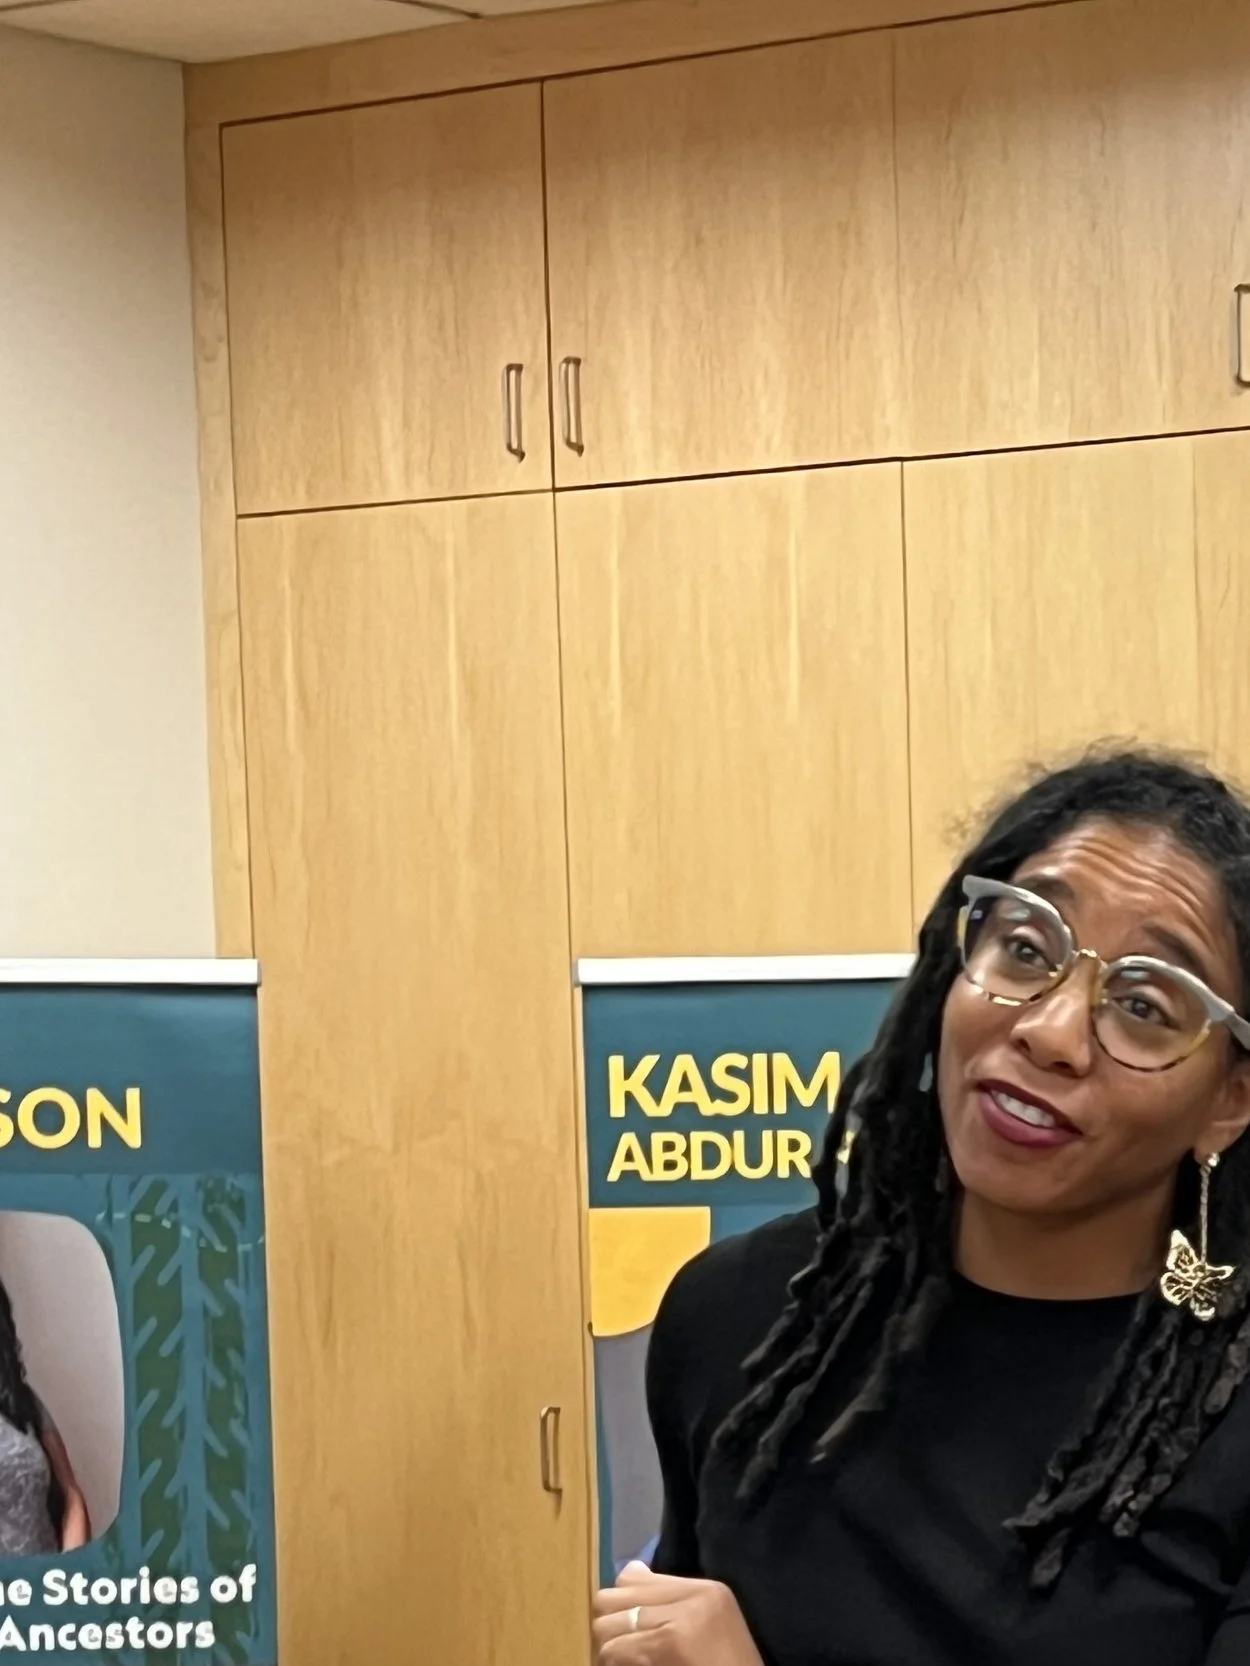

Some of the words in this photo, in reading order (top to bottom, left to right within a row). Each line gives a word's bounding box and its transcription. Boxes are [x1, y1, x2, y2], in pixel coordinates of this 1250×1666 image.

[608, 1051, 841, 1117] KASIM
[607, 1129, 812, 1182] ABDUR
[0, 1578, 32, 1607] e
[43, 1566, 200, 1606] Stories
[210, 1563, 257, 1603] of
[0, 1615, 216, 1651] Ancestors
